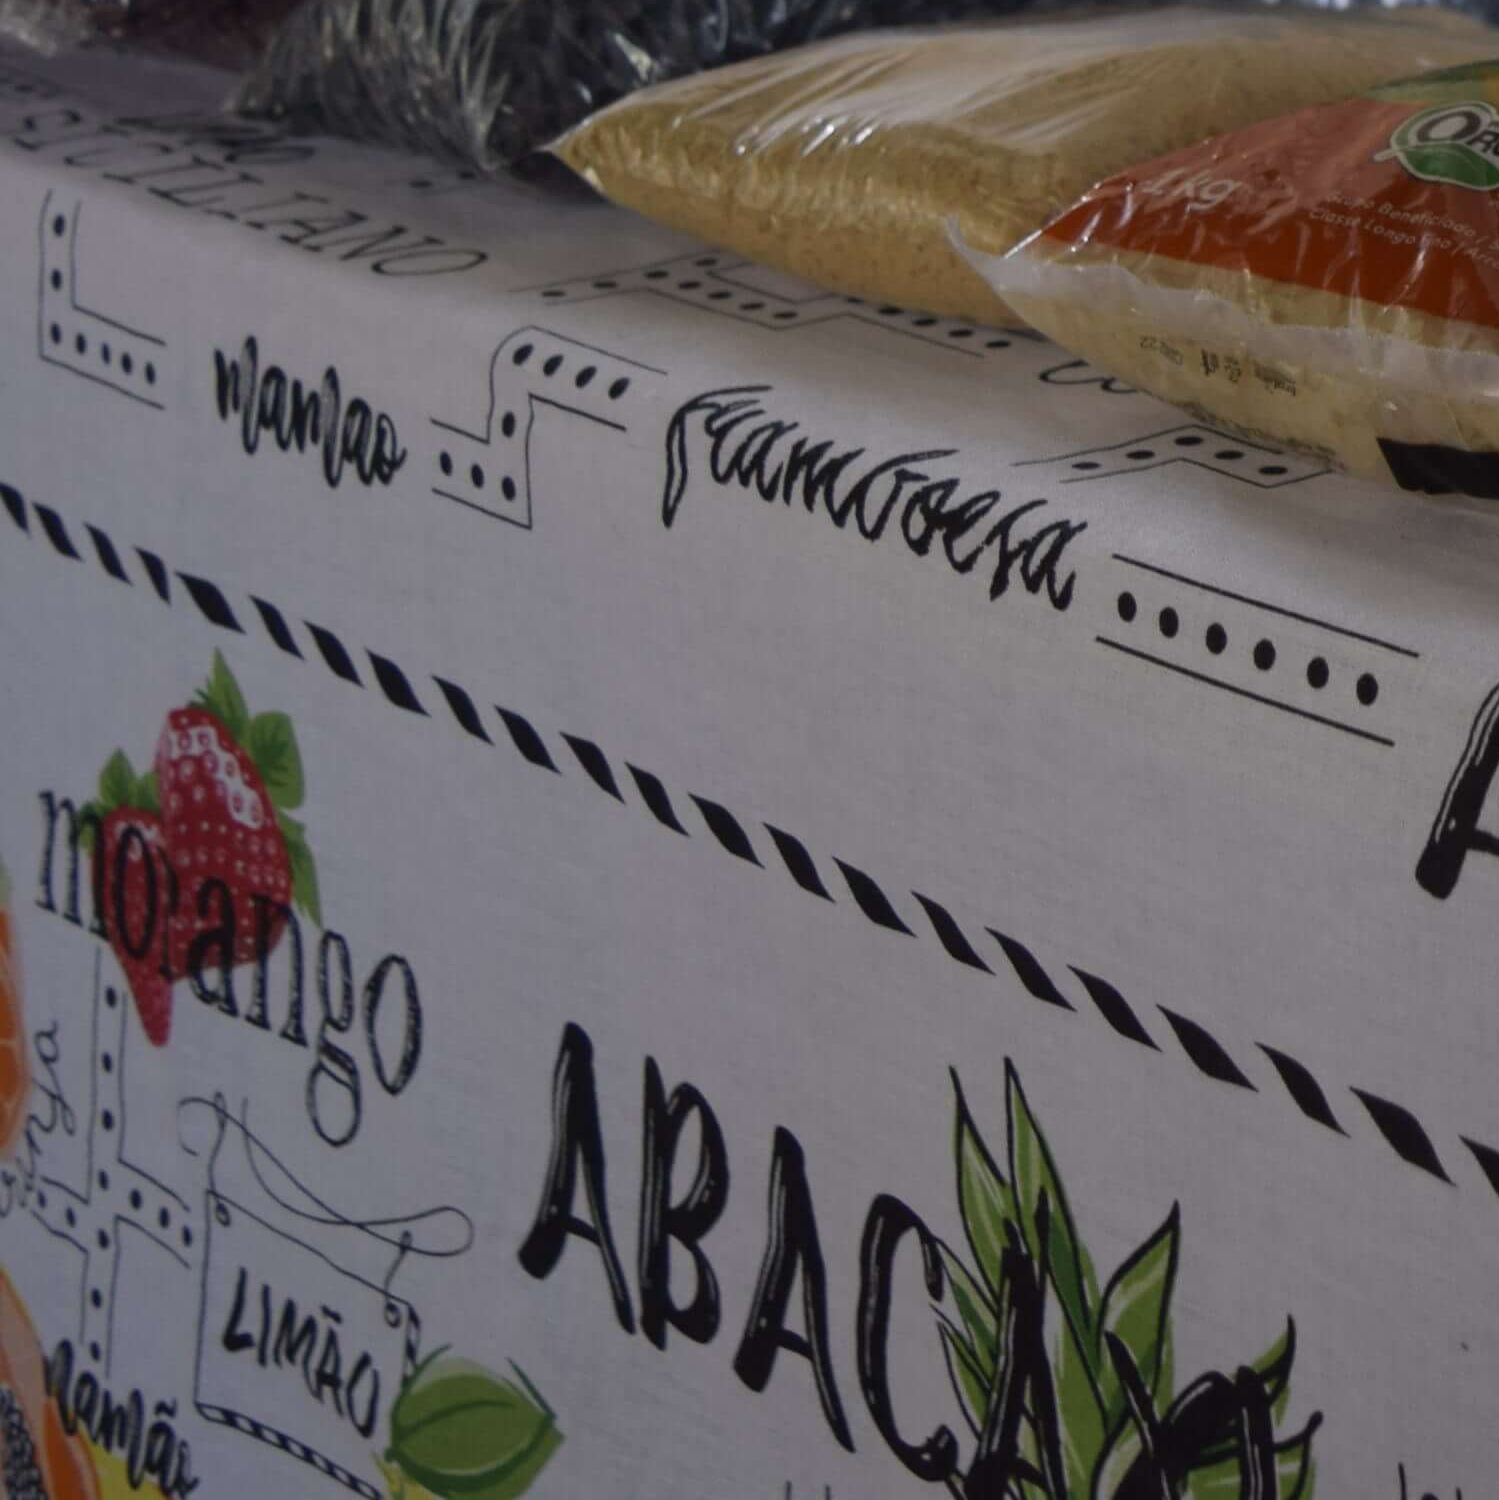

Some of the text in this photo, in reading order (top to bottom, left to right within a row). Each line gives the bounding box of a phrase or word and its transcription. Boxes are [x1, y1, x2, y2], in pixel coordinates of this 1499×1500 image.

[1362, 219, 1417, 247] Longo
[1377, 199, 1477, 240] Beneficiado
[36, 789, 424, 1149] morango
[221, 1266, 381, 1439] LIMÃO
